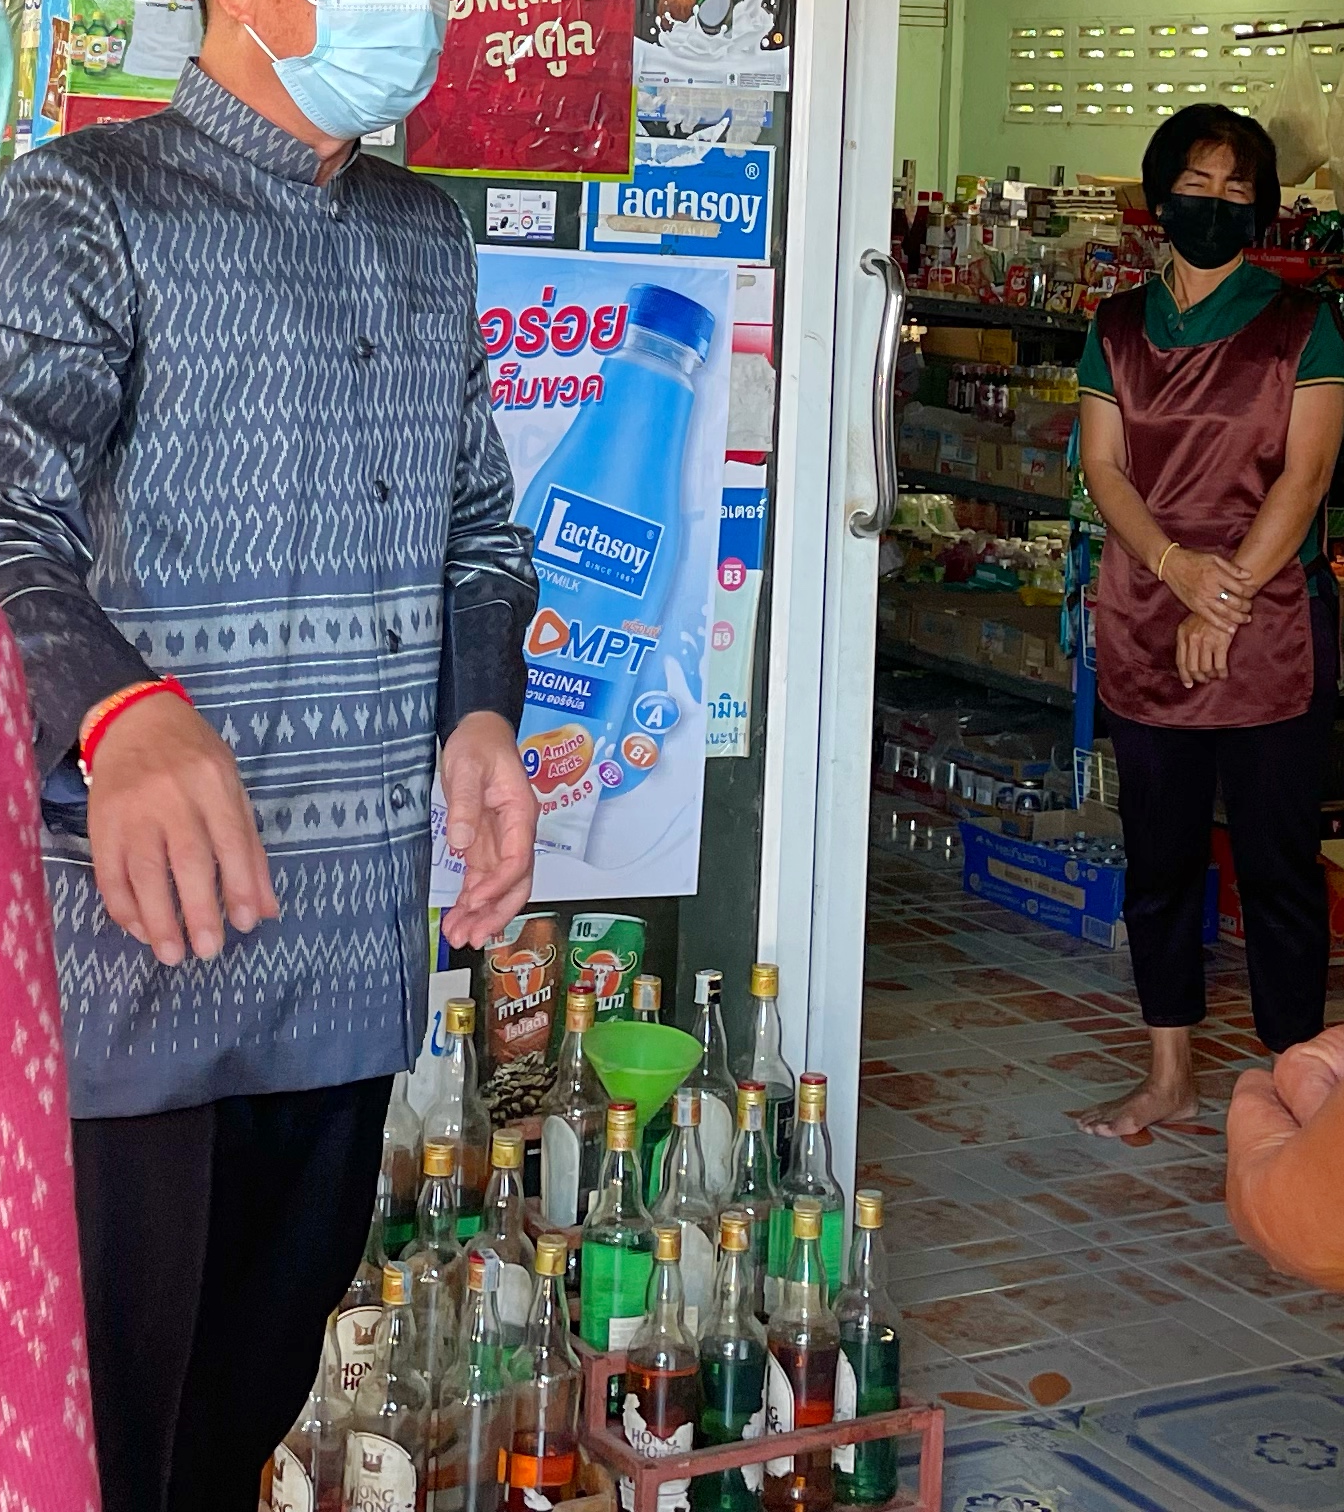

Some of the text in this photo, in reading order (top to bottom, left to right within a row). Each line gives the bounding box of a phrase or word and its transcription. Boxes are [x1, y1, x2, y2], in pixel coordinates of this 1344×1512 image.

[478, 285, 630, 357] อร่อย
[491, 361, 605, 409] ต็มขวด
[537, 496, 651, 575] Lactasoy
[534, 567, 582, 594] OYMILK
[723, 568, 742, 586] B3
[526, 668, 593, 698] RIGINAL
[645, 705, 664, 728] A
[542, 733, 585, 763] Amino
[629, 744, 652, 765] B1
[547, 754, 584, 780] Acids
[602, 767, 619, 786] B2
[576, 921, 592, 938] 10
[498, 986, 553, 1022] คาราบาว
[595, 993, 625, 1012] าบาว
[341, 1362, 373, 1377] HON
